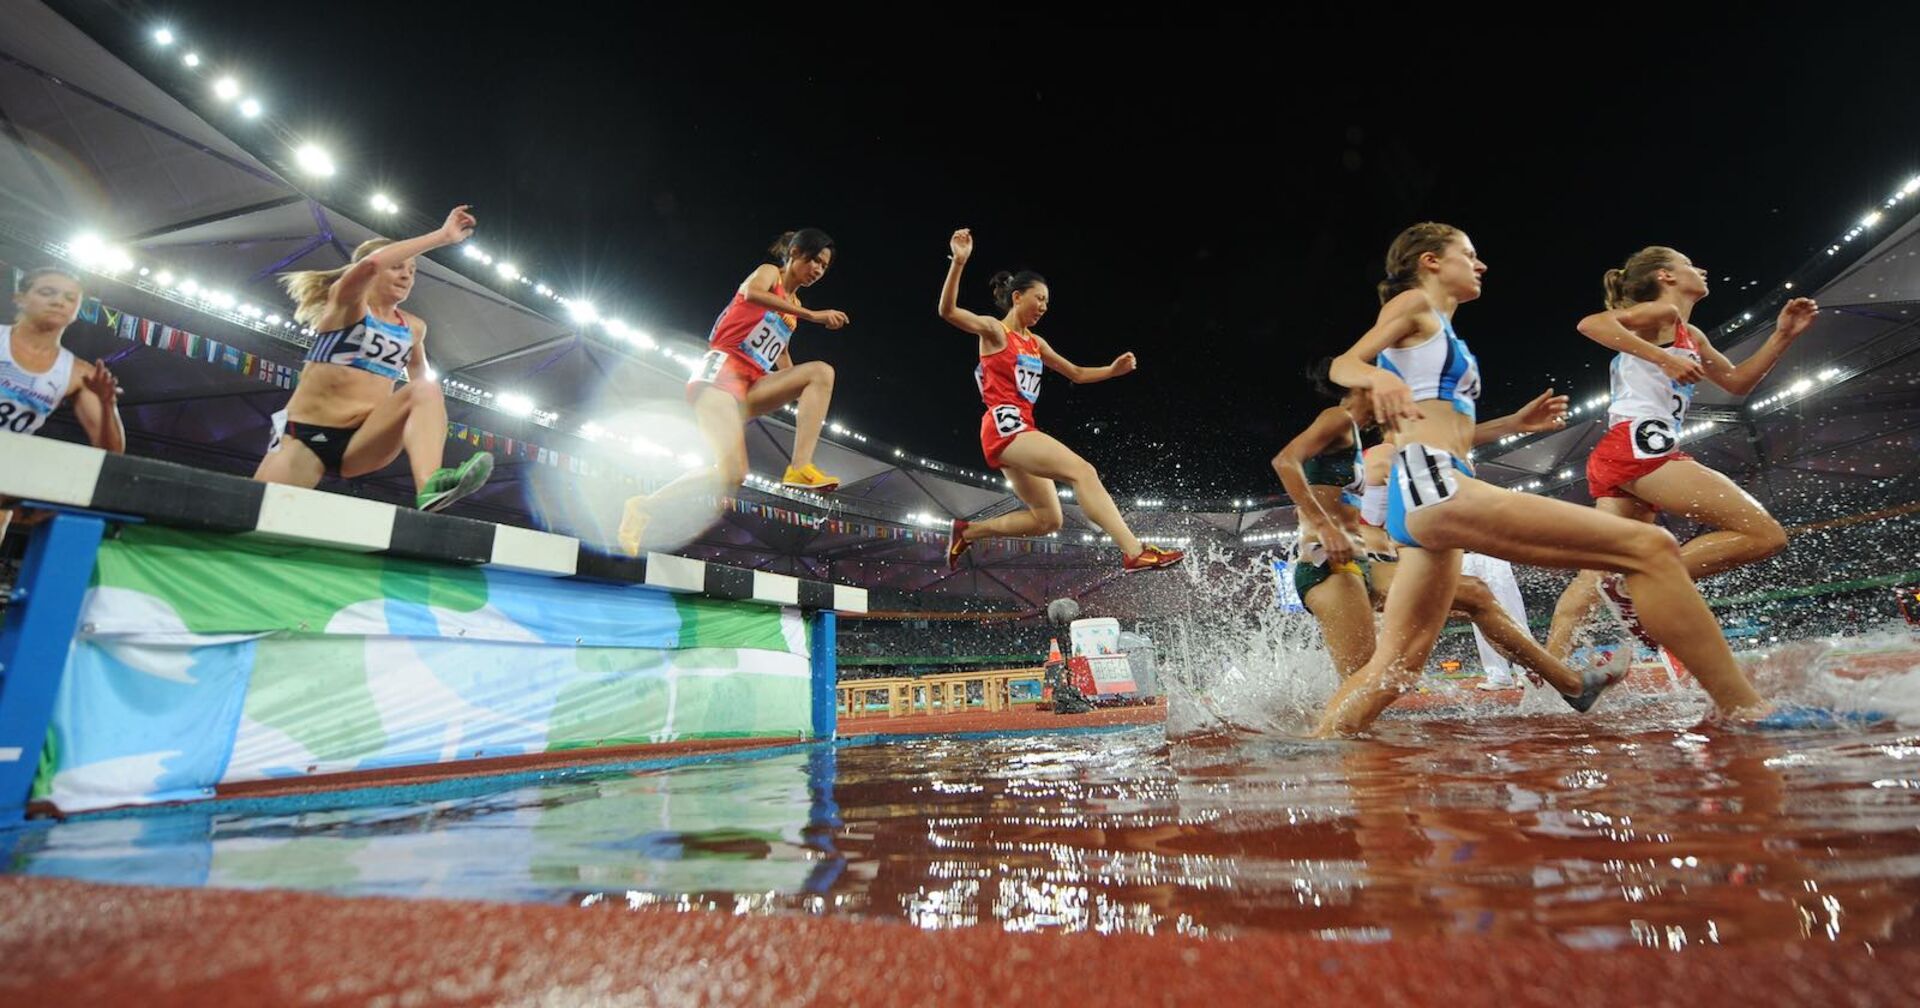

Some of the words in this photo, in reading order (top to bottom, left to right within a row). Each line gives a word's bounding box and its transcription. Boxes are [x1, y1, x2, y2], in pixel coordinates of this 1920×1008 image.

[365, 332, 412, 368] 524
[751, 326, 782, 362] 310
[1017, 368, 1043, 394] 277
[995, 406, 1023, 433] 5
[1635, 419, 1676, 455] 6
[1399, 444, 1450, 507] 11
